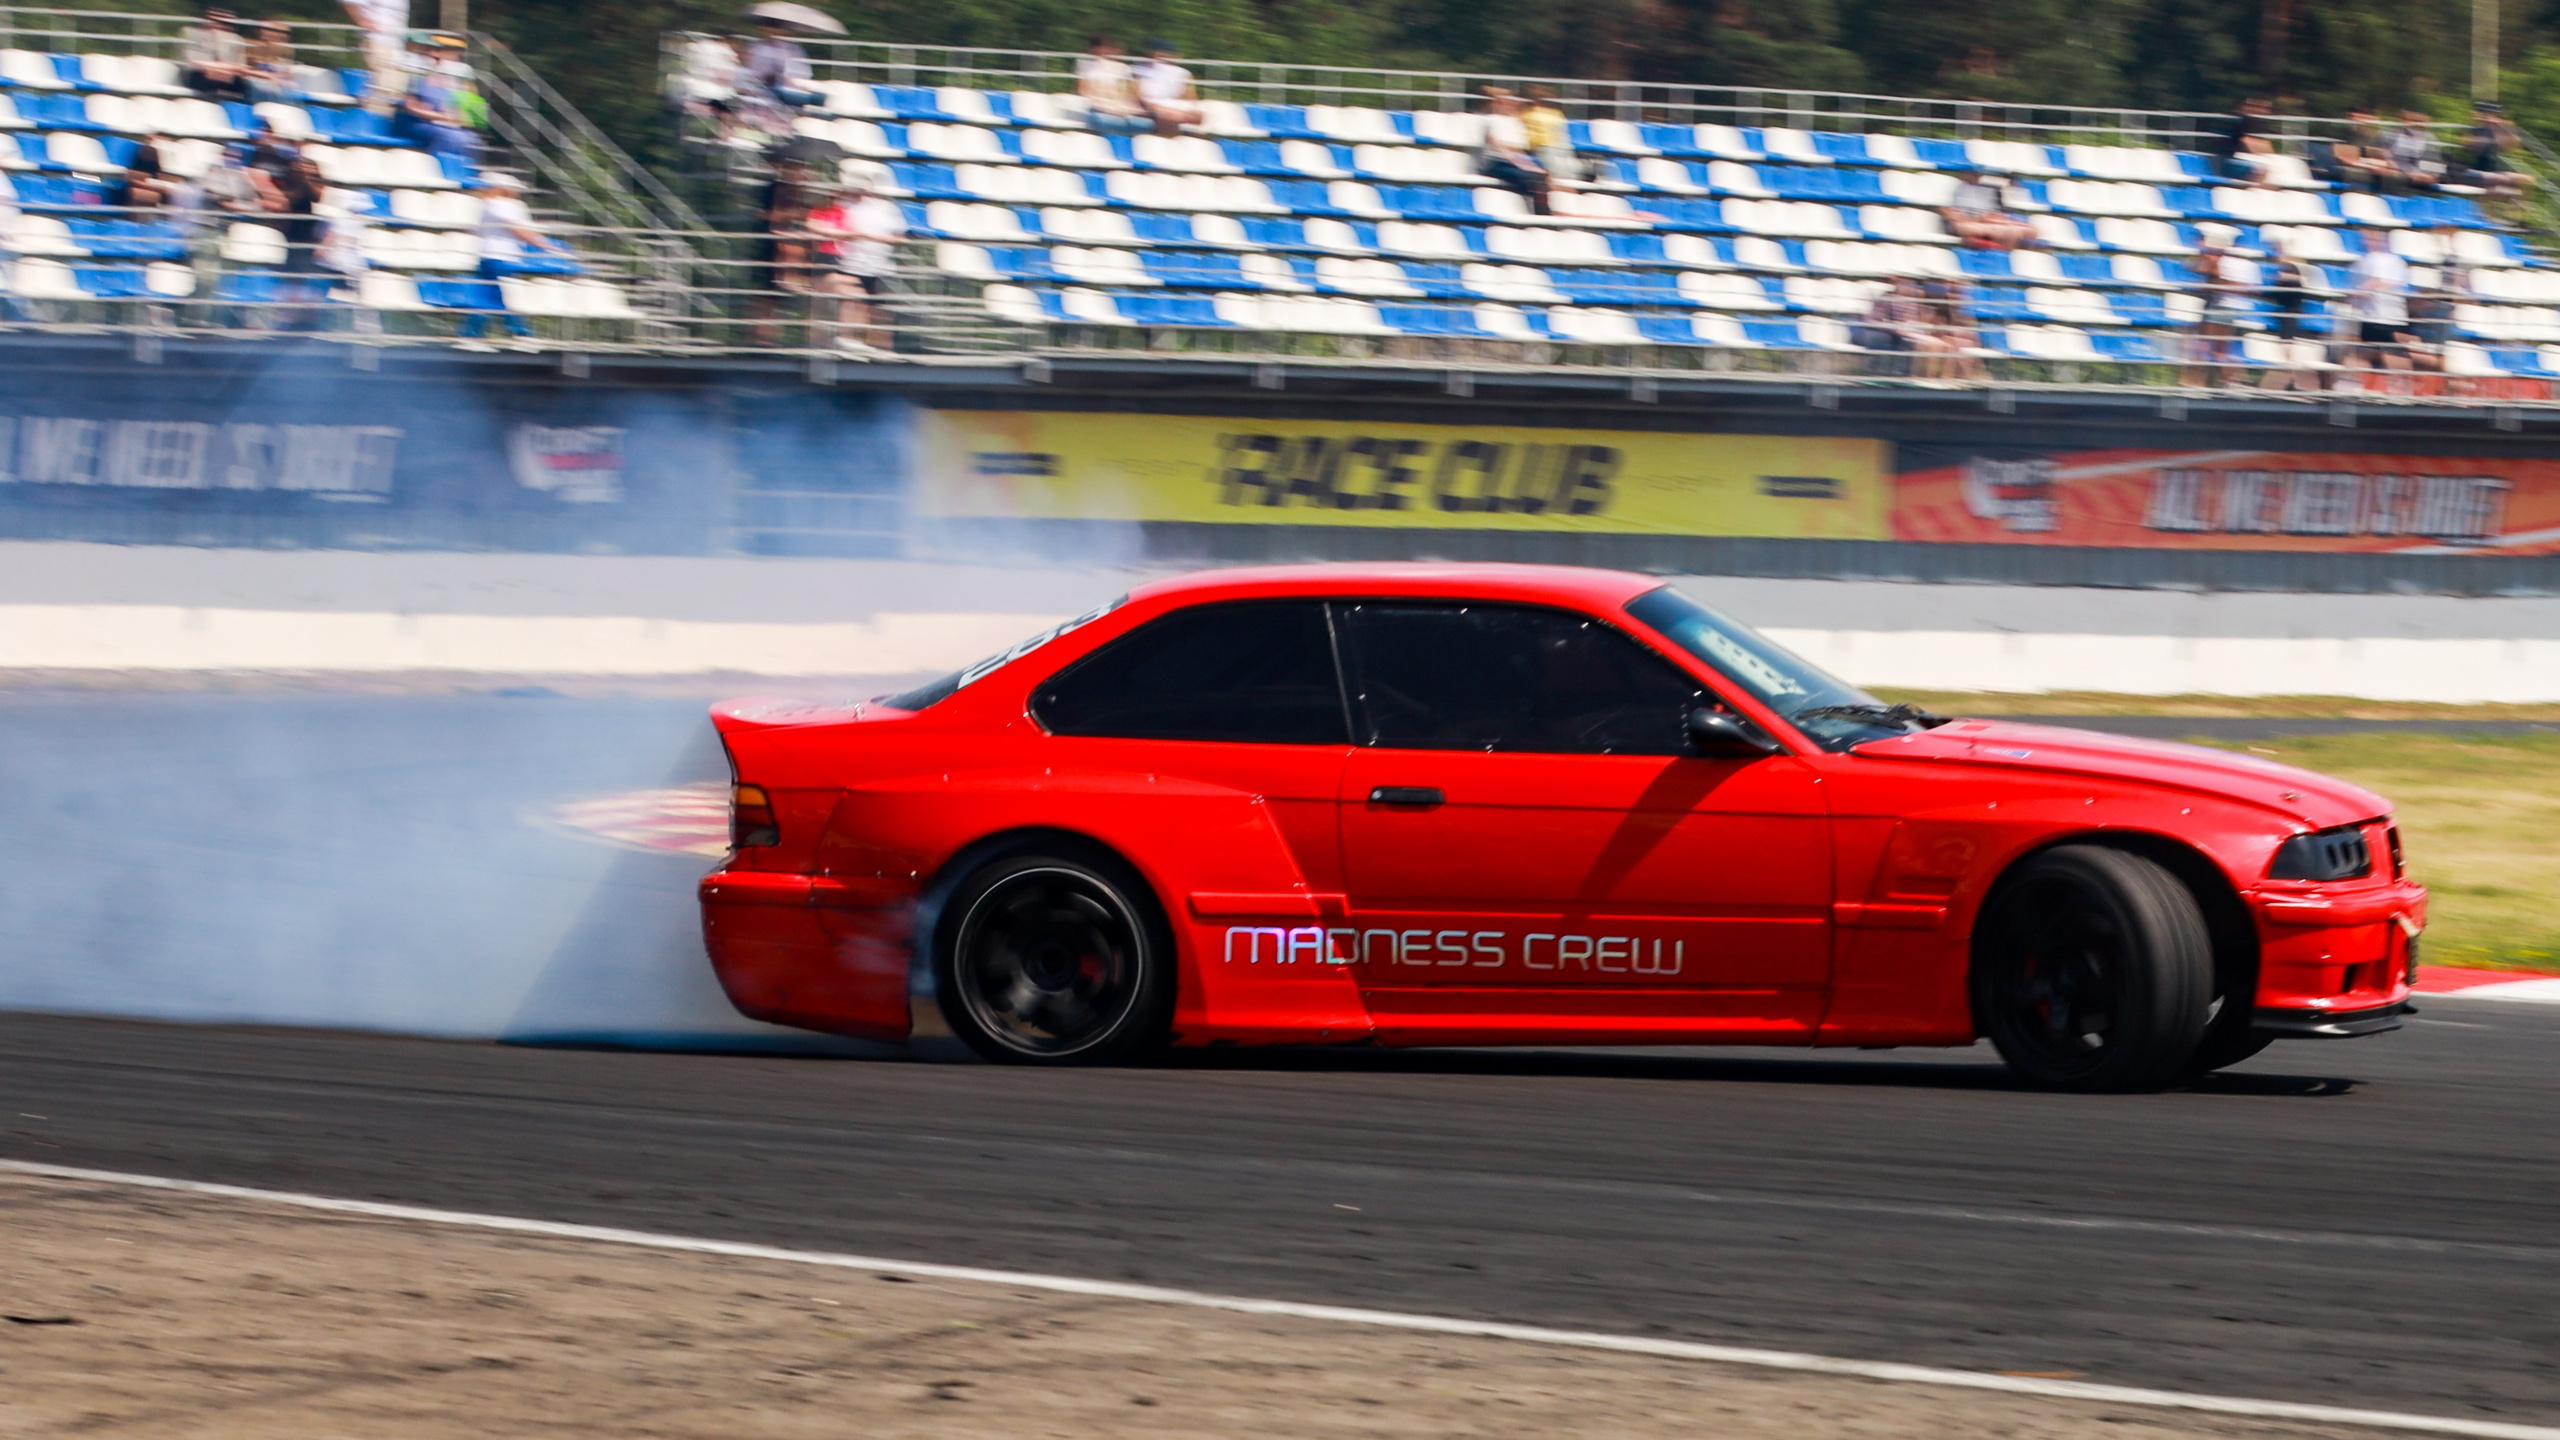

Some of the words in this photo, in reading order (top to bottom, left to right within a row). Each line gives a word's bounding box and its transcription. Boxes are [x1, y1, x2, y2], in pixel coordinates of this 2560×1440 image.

[1216, 432, 1427, 511] RACE
[1432, 439, 1622, 515] CLUB
[2145, 468, 2216, 530] ALL
[2220, 470, 2284, 533] WE
[2281, 471, 2364, 534] NEED
[2409, 475, 2513, 537] DRIFT
[1224, 926, 1506, 967] MADNESS
[1523, 933, 1684, 975] CREW
